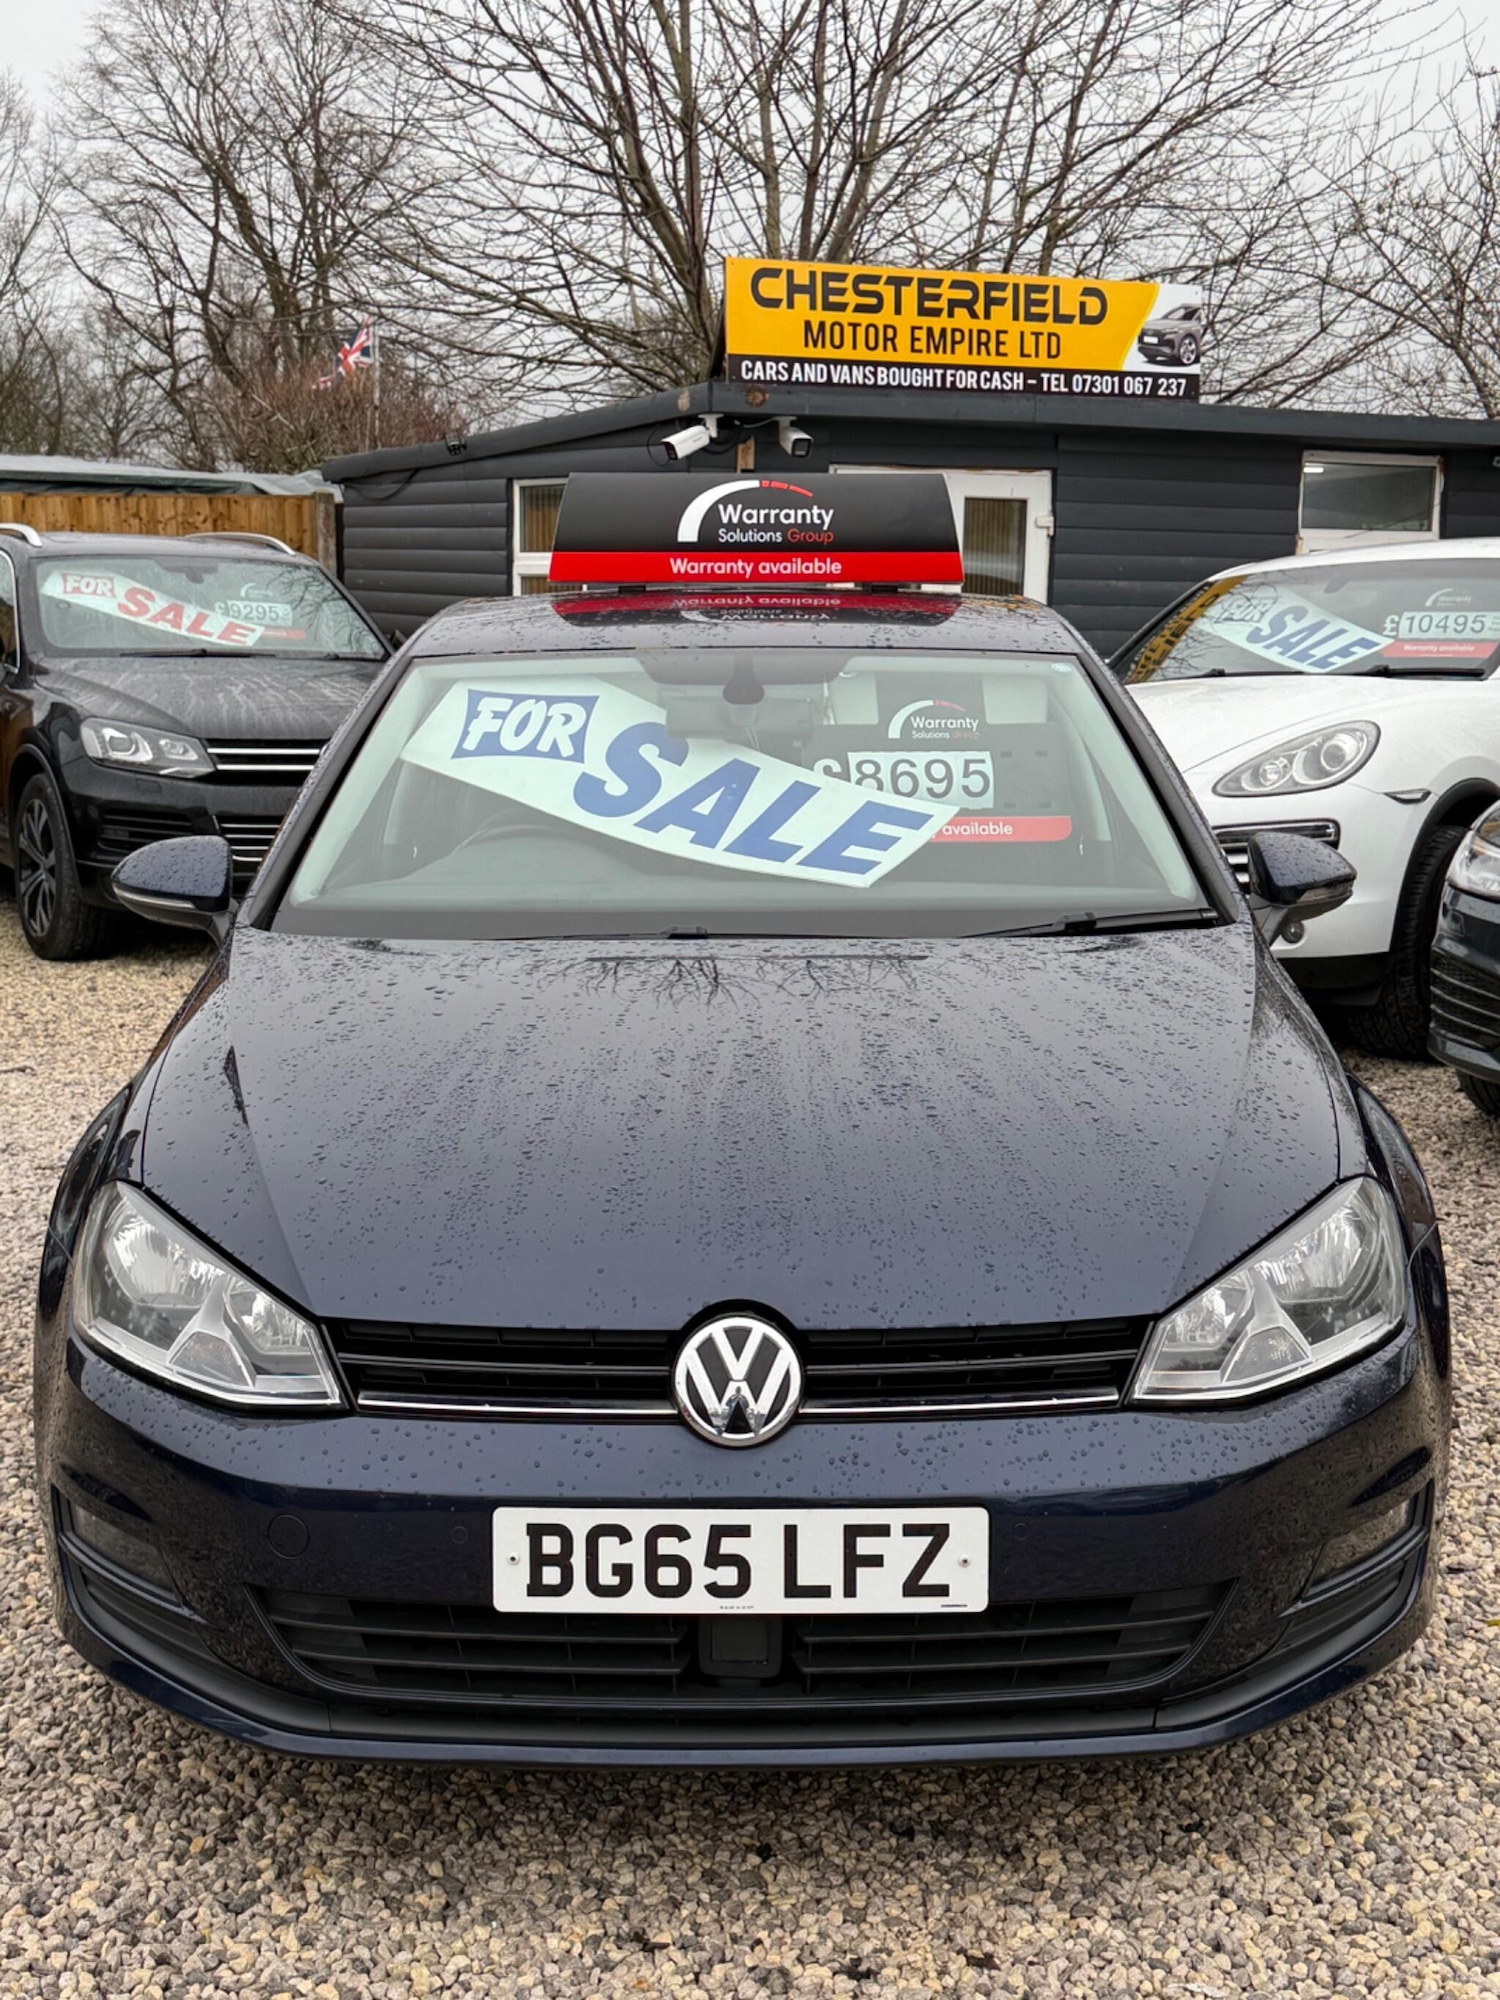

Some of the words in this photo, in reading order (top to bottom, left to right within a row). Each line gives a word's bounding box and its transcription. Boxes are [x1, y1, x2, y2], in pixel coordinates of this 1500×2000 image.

[750, 267, 1108, 325] CHESTERFIELD
[803, 319, 898, 353] MOTOR
[909, 326, 1008, 357] EMPIRE
[1019, 331, 1061, 359] LTD
[741, 359, 788, 381] CARS
[791, 362, 828, 384] AND
[829, 364, 875, 386] VANS
[876, 366, 945, 389] BOUGHT
[946, 369, 977, 390] FOR
[979, 370, 1024, 391] CASH
[1040, 373, 1069, 393] TEL
[1072, 374, 1120, 394] 07301
[1123, 376, 1154, 395] 067
[1157, 377, 1188, 397] 237
[717, 504, 834, 531] Warranty
[718, 527, 783, 544] Solutions
[786, 527, 834, 545] Group
[669, 557, 753, 579] Warranty
[757, 557, 843, 576] available
[65, 575, 114, 596] FOR
[117, 586, 256, 645] SALE
[1246, 605, 1381, 670] SALE
[910, 716, 979, 731] Warranty
[912, 730, 950, 740] Solutions
[462, 697, 587, 757] FOR
[572, 721, 934, 875] SALE
[942, 822, 1014, 836] available
[526, 1523, 752, 1599] BG65
[783, 1523, 951, 1599] LFZ
